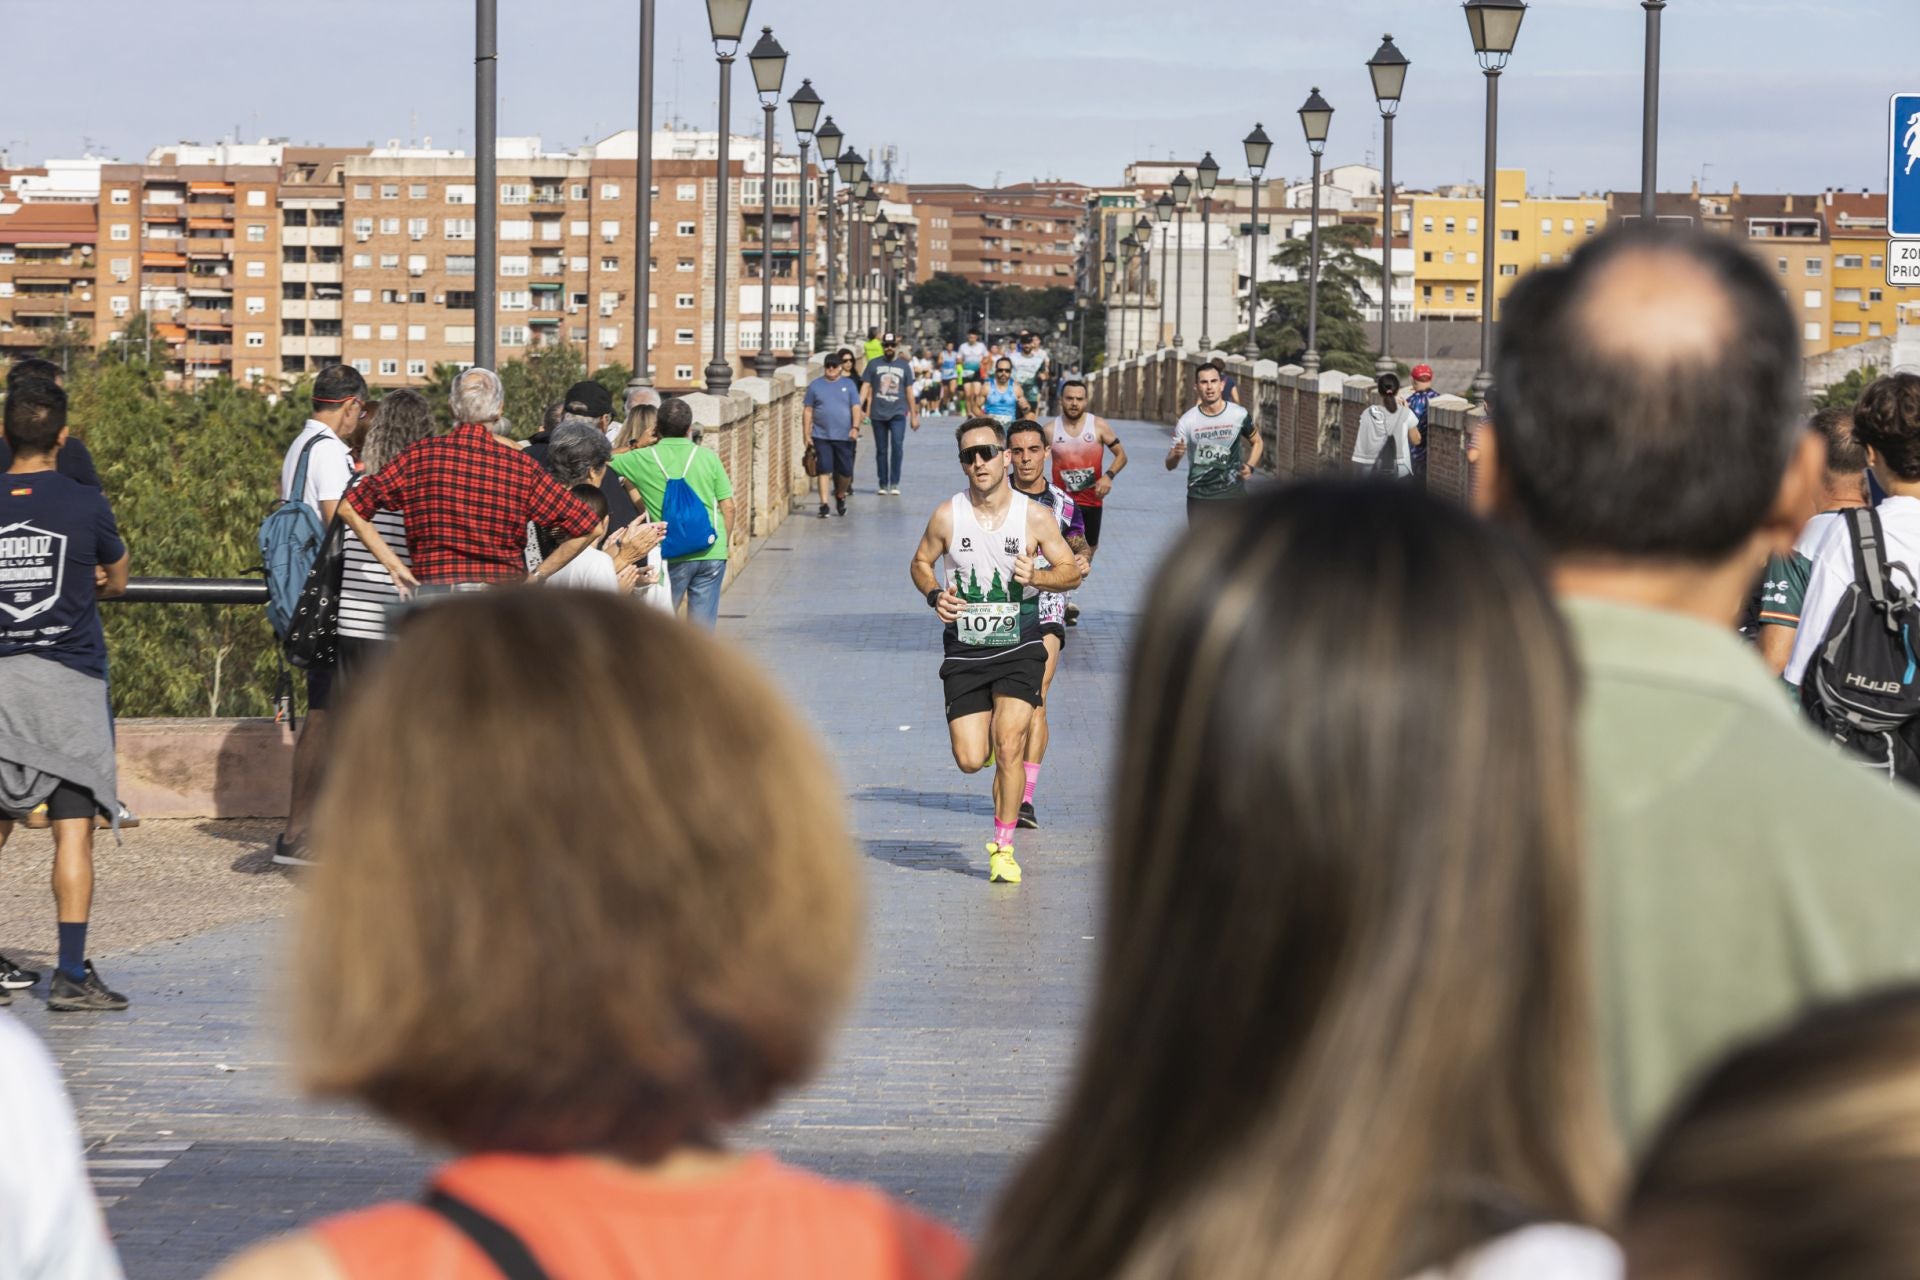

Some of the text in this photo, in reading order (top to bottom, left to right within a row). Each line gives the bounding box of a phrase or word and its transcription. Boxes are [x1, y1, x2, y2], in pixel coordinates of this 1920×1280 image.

[1901, 247, 1920, 260] ZO
[0, 558, 45, 567] ELVAS
[962, 616, 1016, 632] 1079
[1845, 673, 1901, 694] HUUB
